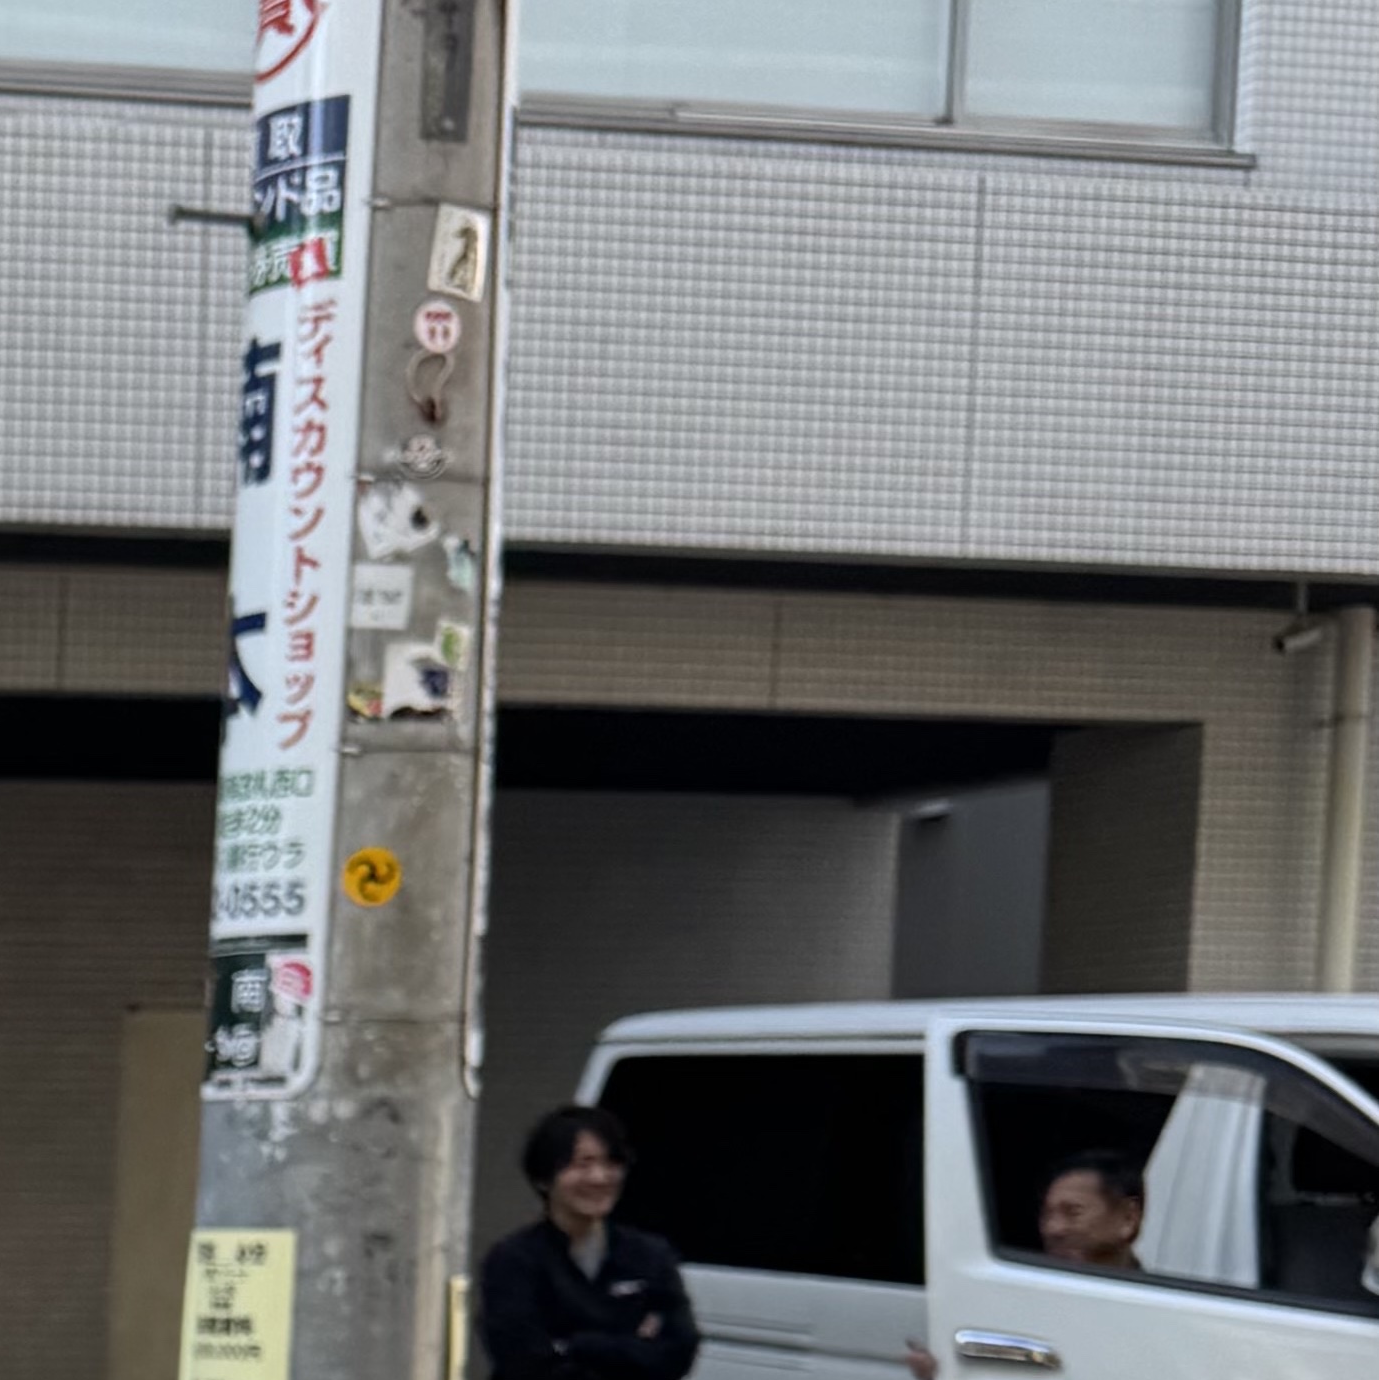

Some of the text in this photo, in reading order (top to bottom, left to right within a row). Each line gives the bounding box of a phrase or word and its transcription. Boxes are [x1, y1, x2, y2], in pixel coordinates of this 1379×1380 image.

[277, 299, 338, 750] ディスカウントショップ
